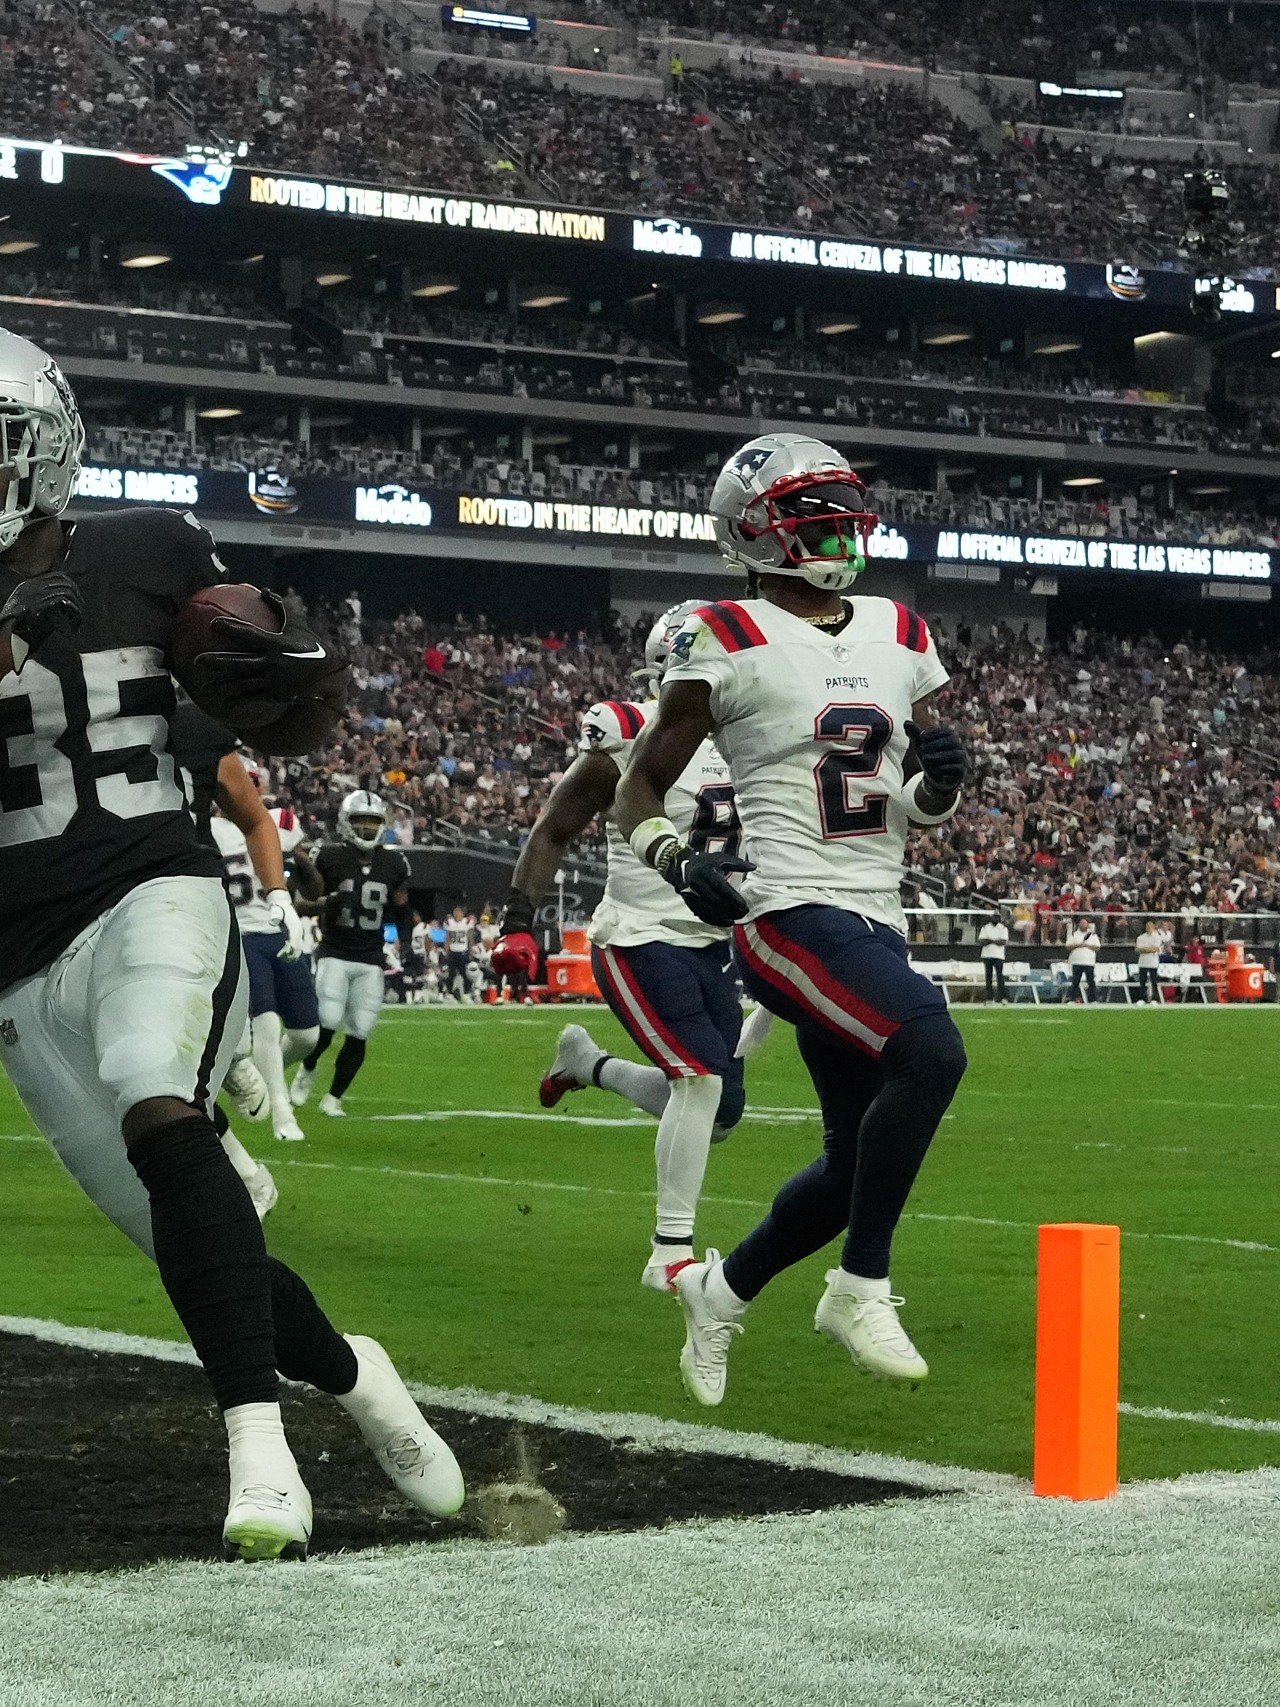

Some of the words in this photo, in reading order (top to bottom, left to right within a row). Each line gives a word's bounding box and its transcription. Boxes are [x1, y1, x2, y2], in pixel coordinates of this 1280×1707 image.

[250, 176, 326, 209] ROOTED
[326, 185, 347, 212] IN
[346, 187, 383, 217] THE
[383, 190, 444, 224] HEART
[444, 196, 471, 227] OF
[472, 202, 538, 234] RAIDER
[540, 210, 605, 241] NATION
[633, 219, 703, 258] Modelo
[754, 235, 818, 265] OFFICIAL
[820, 242, 882, 271] CERVEZA
[883, 248, 903, 273] OF
[904, 250, 933, 277] THE
[934, 253, 961, 280] LAS
[962, 256, 1006, 284] VEGAS
[125, 471, 198, 504] RAIDERS
[355, 487, 432, 526] Modelo
[459, 497, 533, 527] ROOTED
[534, 502, 553, 529] IN
[554, 504, 591, 532] THE
[592, 506, 653, 536] HEART
[654, 511, 679, 538] OF
[679, 511, 718, 541] RAI
[961, 533, 1023, 562] OFFICIAL
[1025, 537, 1086, 566] CERVEZA
[1088, 542, 1108, 567] OF
[1109, 543, 1137, 570] THE
[1139, 545, 1166, 571] LAS
[1167, 547, 1211, 574] VEGAS
[825, 676, 869, 689] PATRIOTS
[701, 765, 729, 775] PATRIOT
[813, 702, 894, 839] 2
[556, 968, 569, 986] G
[1248, 971, 1261, 990] G
